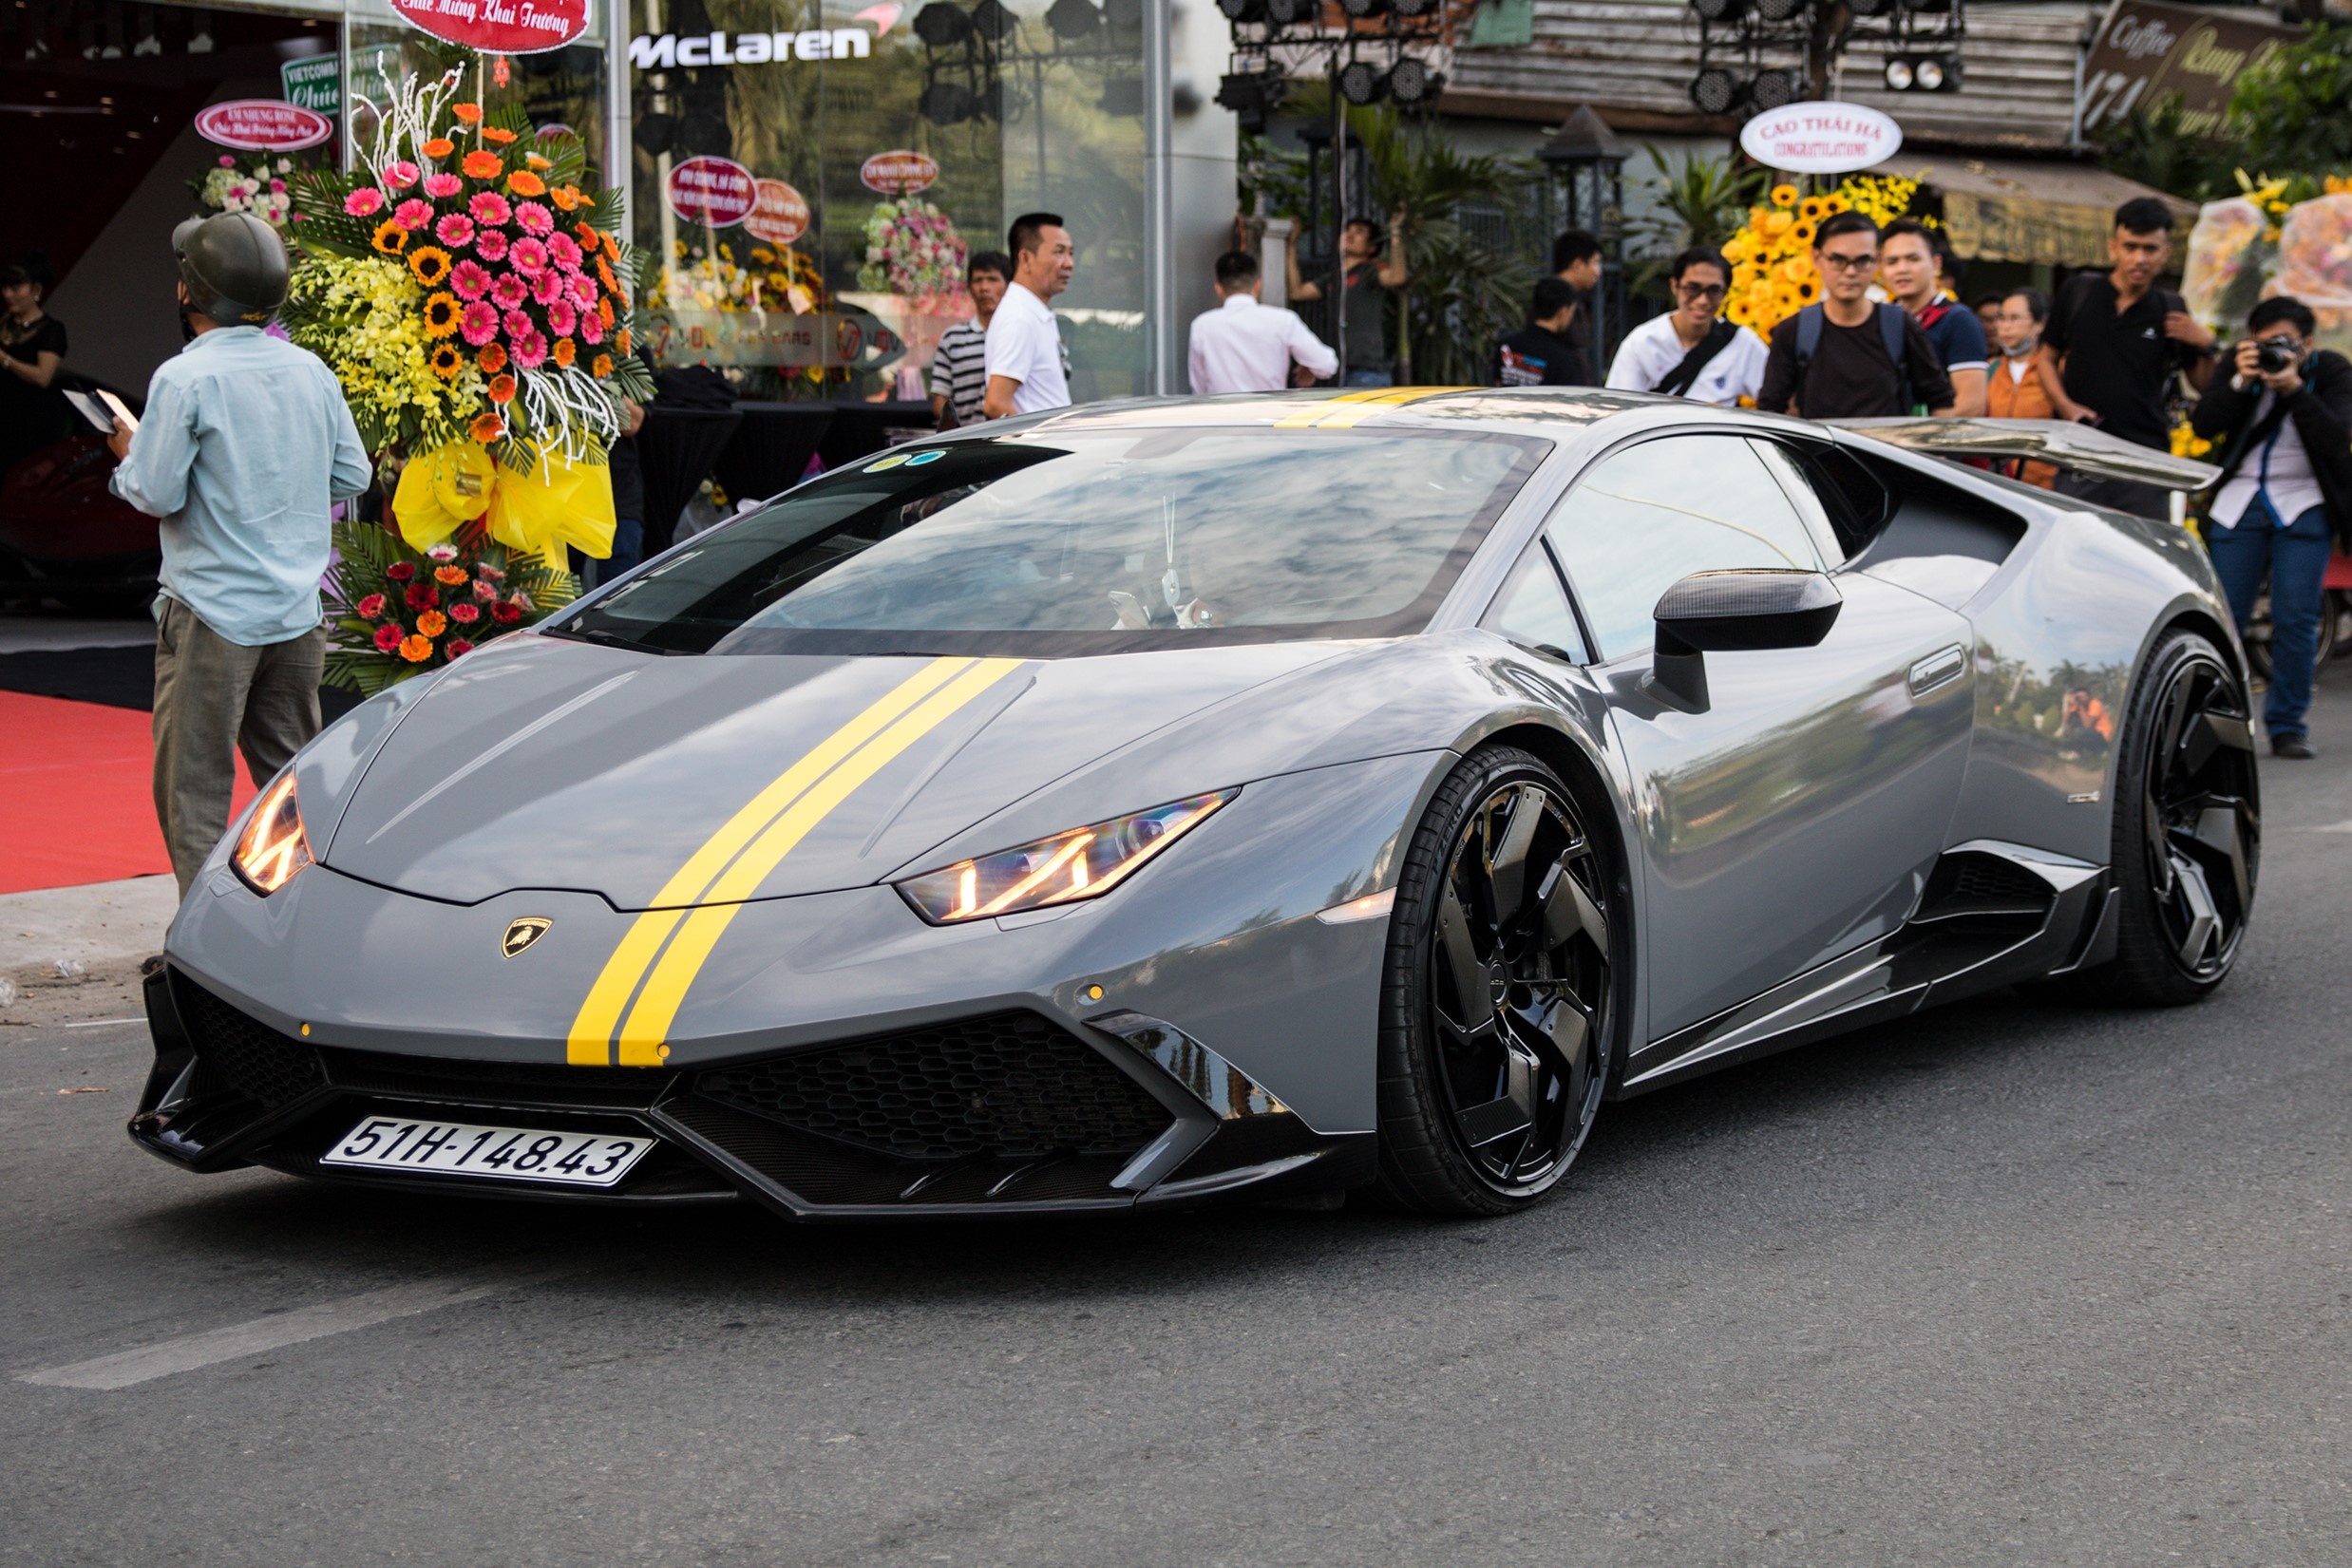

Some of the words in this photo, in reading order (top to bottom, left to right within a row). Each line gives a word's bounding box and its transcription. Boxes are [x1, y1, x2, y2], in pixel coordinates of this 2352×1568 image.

[480, 0, 516, 25] Khai
[521, 2, 569, 38] Trương
[628, 28, 870, 69] McLaren
[1759, 119, 1798, 141] CAO
[1773, 142, 1869, 159] CONGRATULATIONS
[343, 1121, 635, 1178] 51H-148.43
